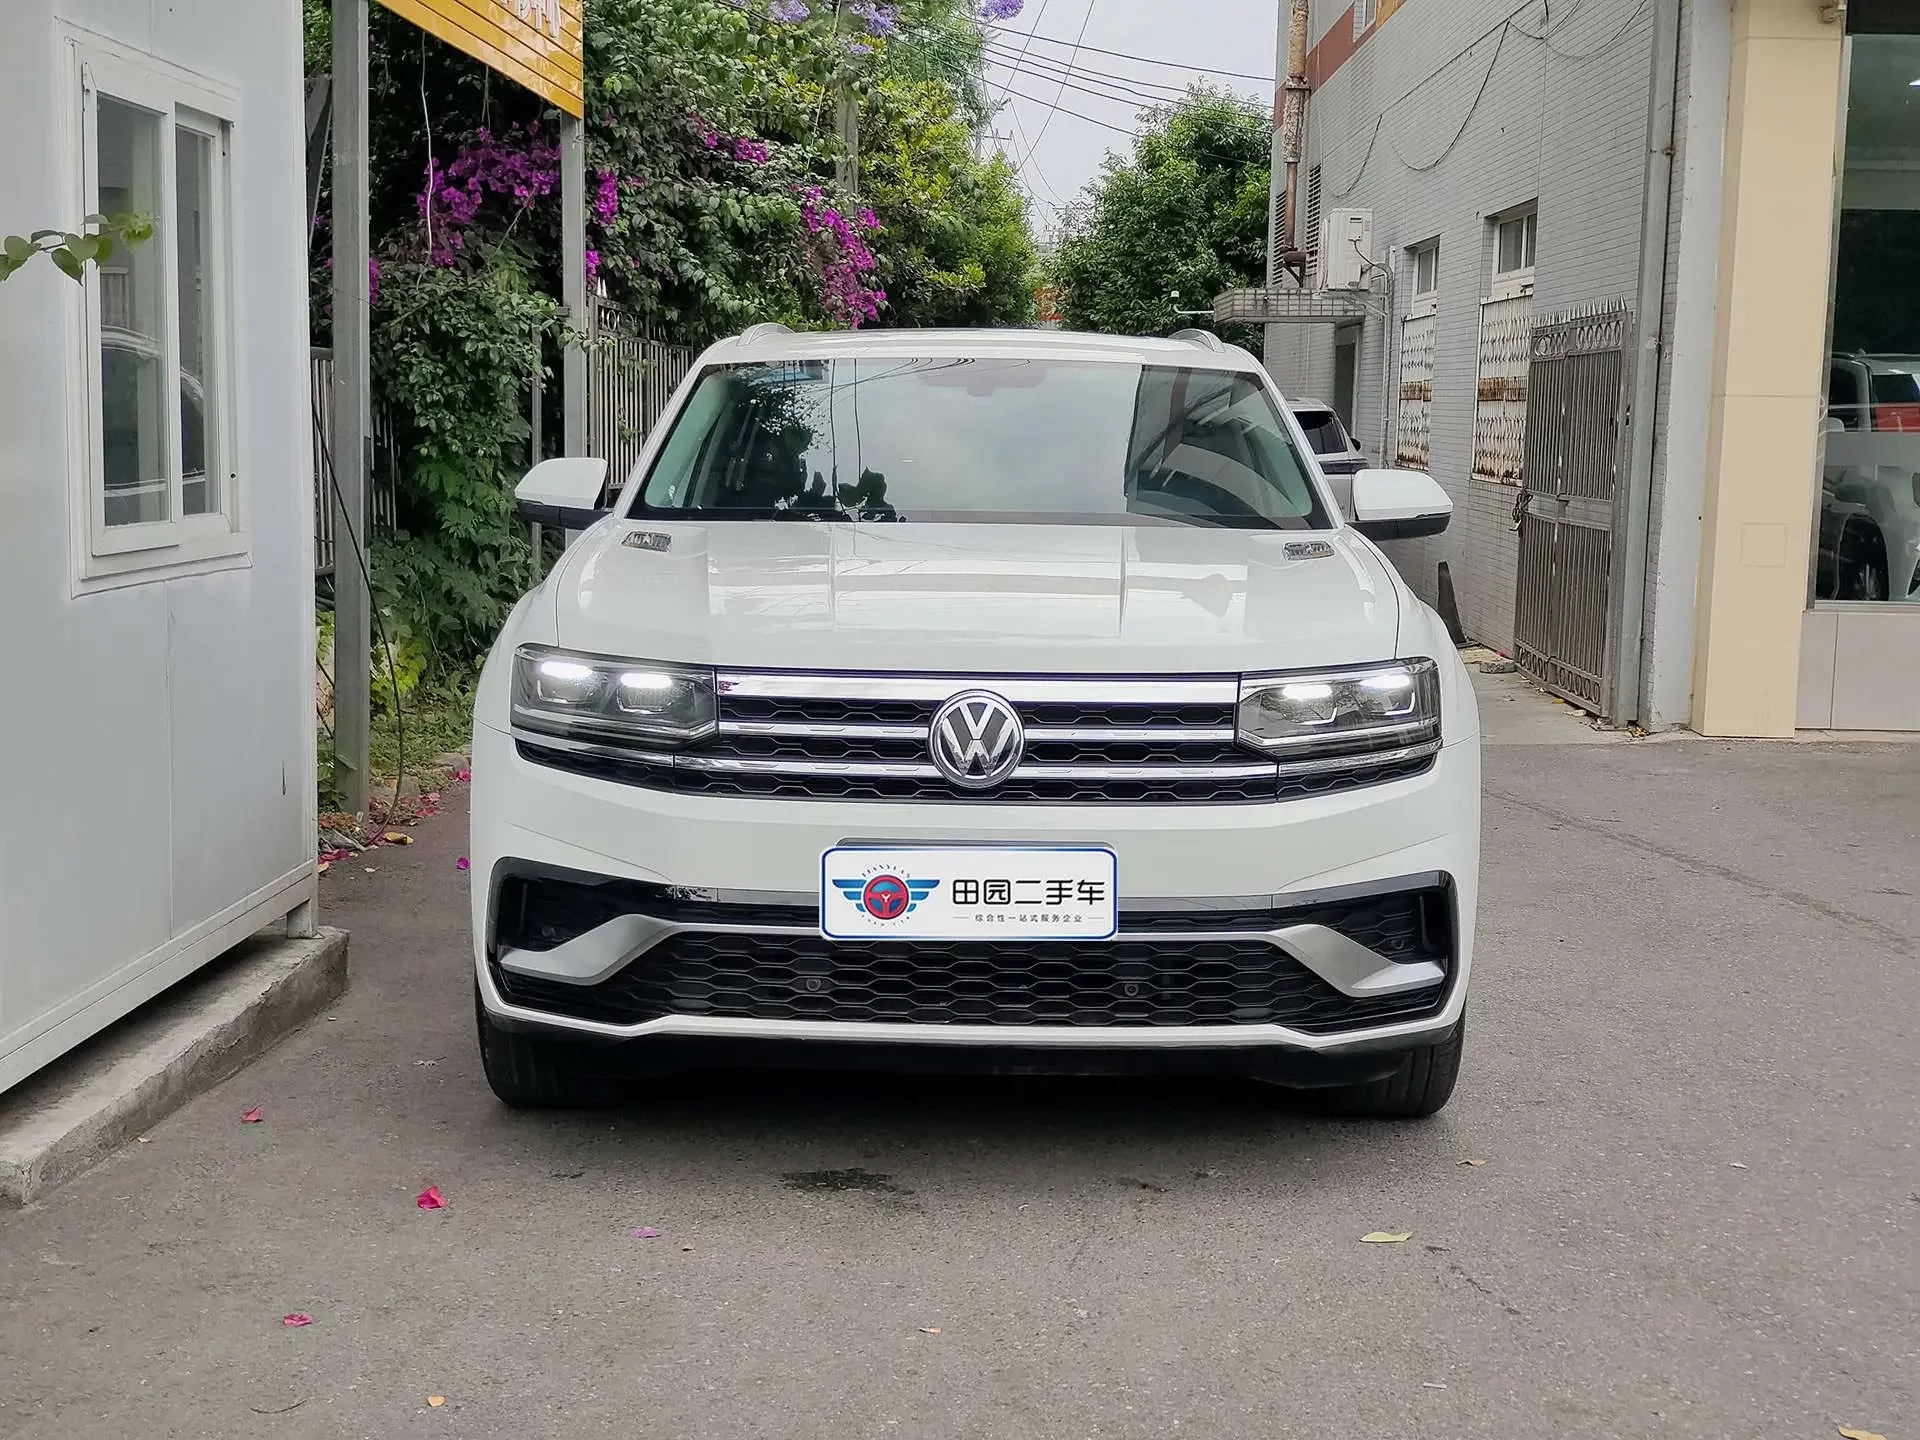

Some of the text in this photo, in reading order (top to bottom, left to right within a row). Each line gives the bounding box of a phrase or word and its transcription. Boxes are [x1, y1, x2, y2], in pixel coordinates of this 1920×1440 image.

[935, 696, 1018, 780] VW
[952, 879, 1105, 905] 田园二手车
[974, 914, 1083, 923] 综合性一站式服务企业
